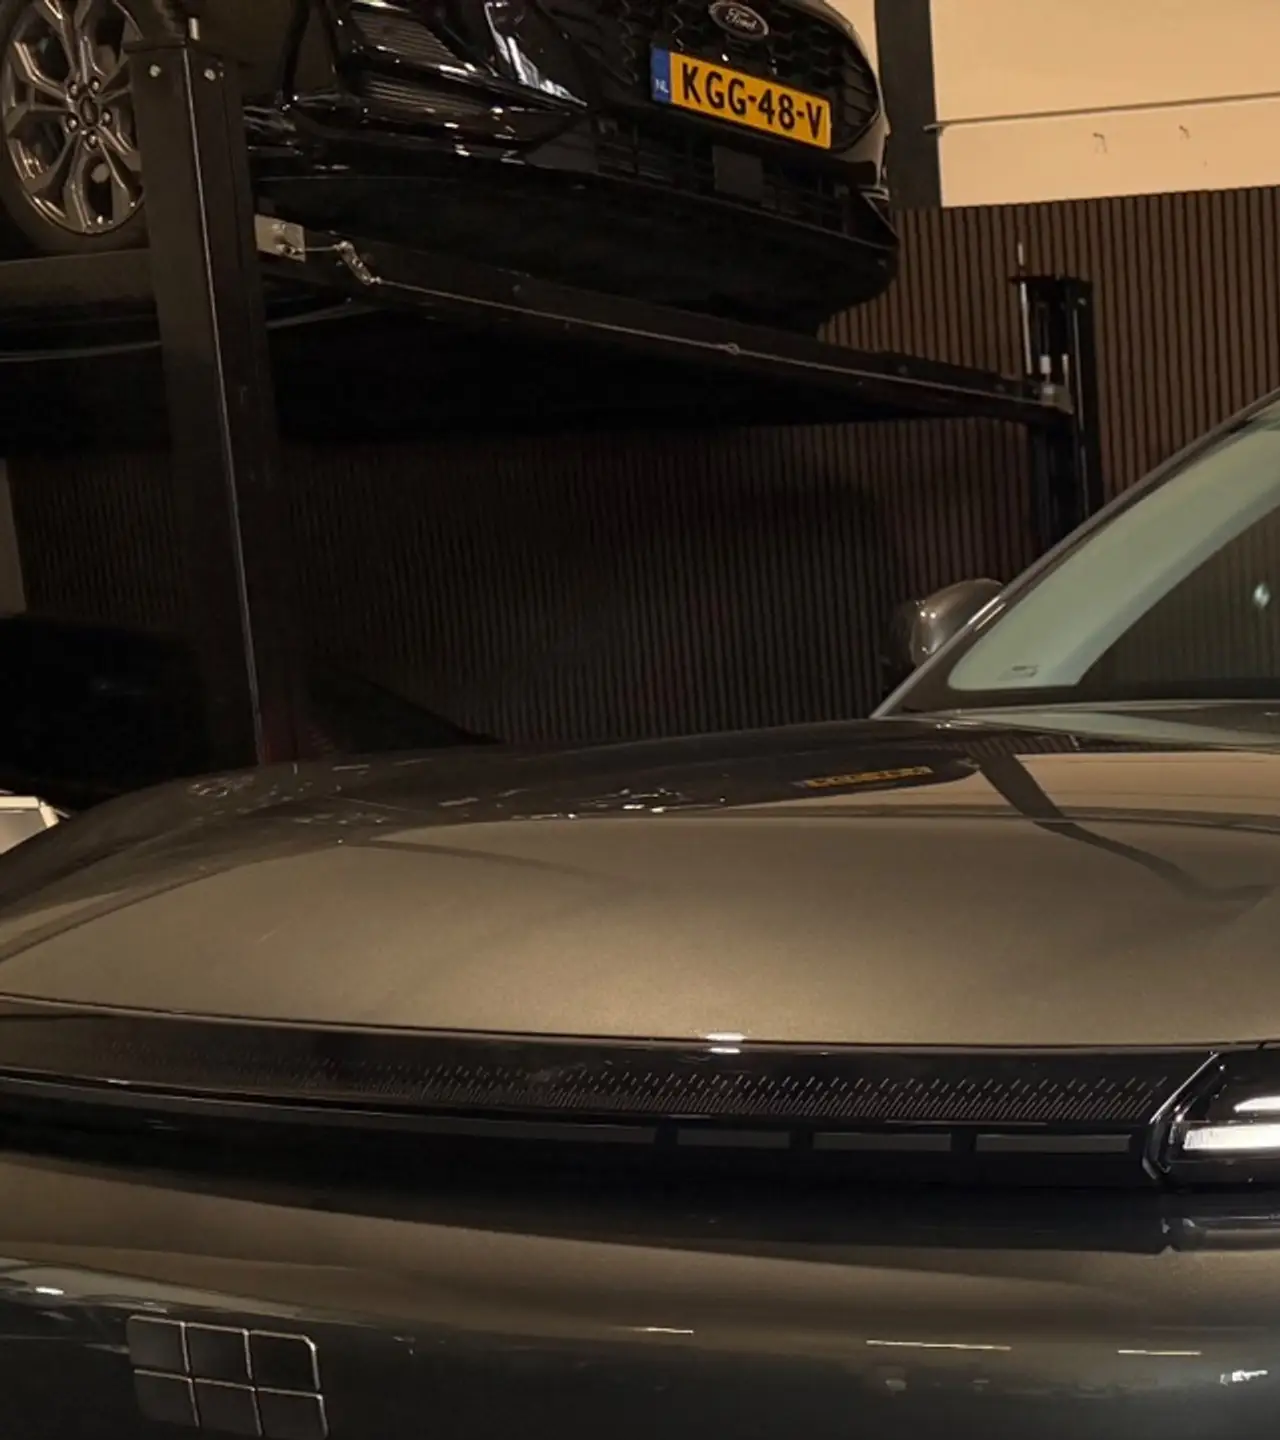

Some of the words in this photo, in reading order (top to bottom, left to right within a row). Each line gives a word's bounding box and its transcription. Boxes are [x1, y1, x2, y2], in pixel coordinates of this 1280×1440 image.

[725, 7, 757, 30] Ford
[655, 78, 669, 93] NL
[682, 62, 822, 139] KGG-48-V
